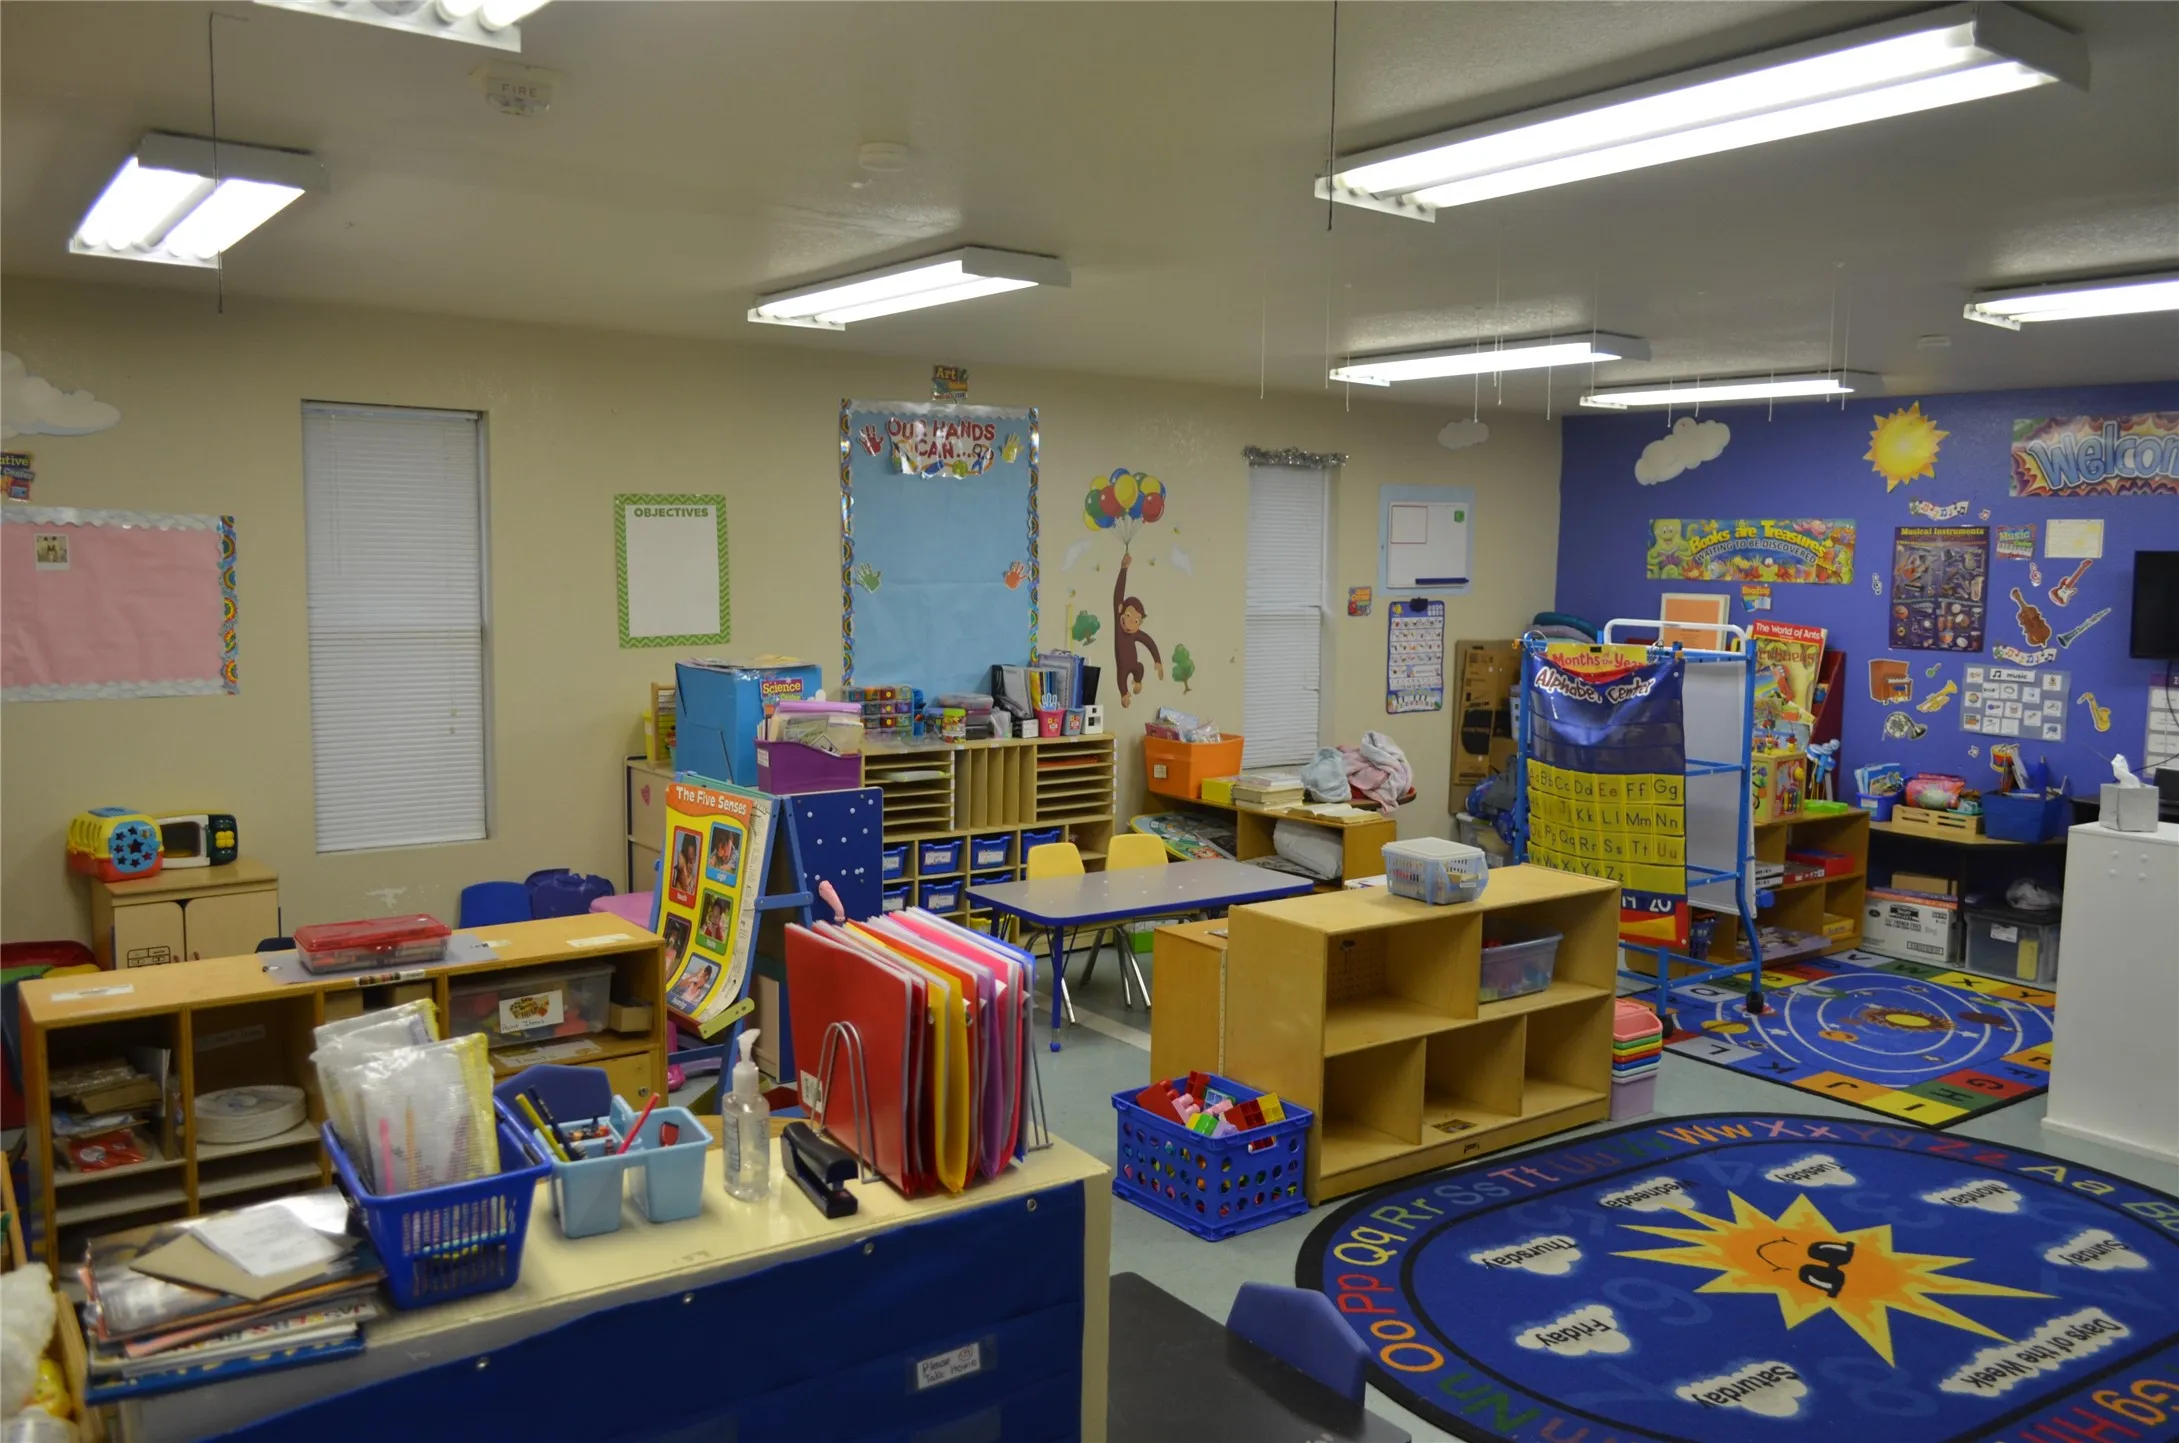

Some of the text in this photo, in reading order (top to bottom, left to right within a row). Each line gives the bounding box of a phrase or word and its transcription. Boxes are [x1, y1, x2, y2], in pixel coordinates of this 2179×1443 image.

[502, 83, 537, 98] FIRE
[935, 367, 957, 380] Art
[887, 417, 927, 440] OU
[634, 507, 709, 518] OBJECTIVES
[1689, 520, 1826, 557] Books are Treasures
[1901, 527, 1985, 536] Musical Instruments
[1999, 529, 2031, 541] Music
[1696, 539, 1817, 563] WAITING TO BE DISCOVERED
[1756, 622, 1821, 640] The World of Ants
[1552, 652, 1600, 667] Months
[762, 682, 801, 694] Science
[2006, 672, 2028, 681] music
[1606, 678, 1656, 703] Center
[1541, 771, 1554, 788] Bb
[1554, 776, 1571, 791] Cc
[1574, 780, 1593, 796] Dd
[1599, 782, 1618, 798] Ee
[1626, 782, 1647, 797] Ff
[1653, 779, 1679, 800] Gg
[675, 785, 695, 801] The
[697, 790, 717, 807] Five
[718, 795, 747, 816] Senses
[1576, 808, 1593, 823] Kk
[1626, 812, 1652, 828] Mm
[1655, 813, 1679, 829] Nn
[1559, 829, 1577, 852] Qq
[1580, 837, 1599, 853] Rr
[1603, 838, 1623, 855] Ss
[1632, 840, 1648, 857] Tt
[1657, 844, 1678, 859] Uu
[1605, 866, 1625, 881] Zz
[1655, 1123, 1754, 1145] Ww
[1750, 1119, 1841, 1139] Xx
[1487, 1164, 1561, 1189] Tt
[1773, 1160, 1847, 1184] Tuesday
[1433, 1181, 1511, 1206] Ss
[1941, 1182, 2012, 1208] Monday
[1370, 1197, 1445, 1231] Rr
[1333, 1225, 1408, 1267] Qq
[1481, 1237, 1579, 1271] Thursday
[2059, 1237, 2131, 1267] Sunday
[1336, 1273, 1397, 1315] Pp
[1535, 1317, 1614, 1348] Friday
[1960, 1317, 2123, 1390] Days of the Week
[1691, 1364, 1800, 1410] Saturday
